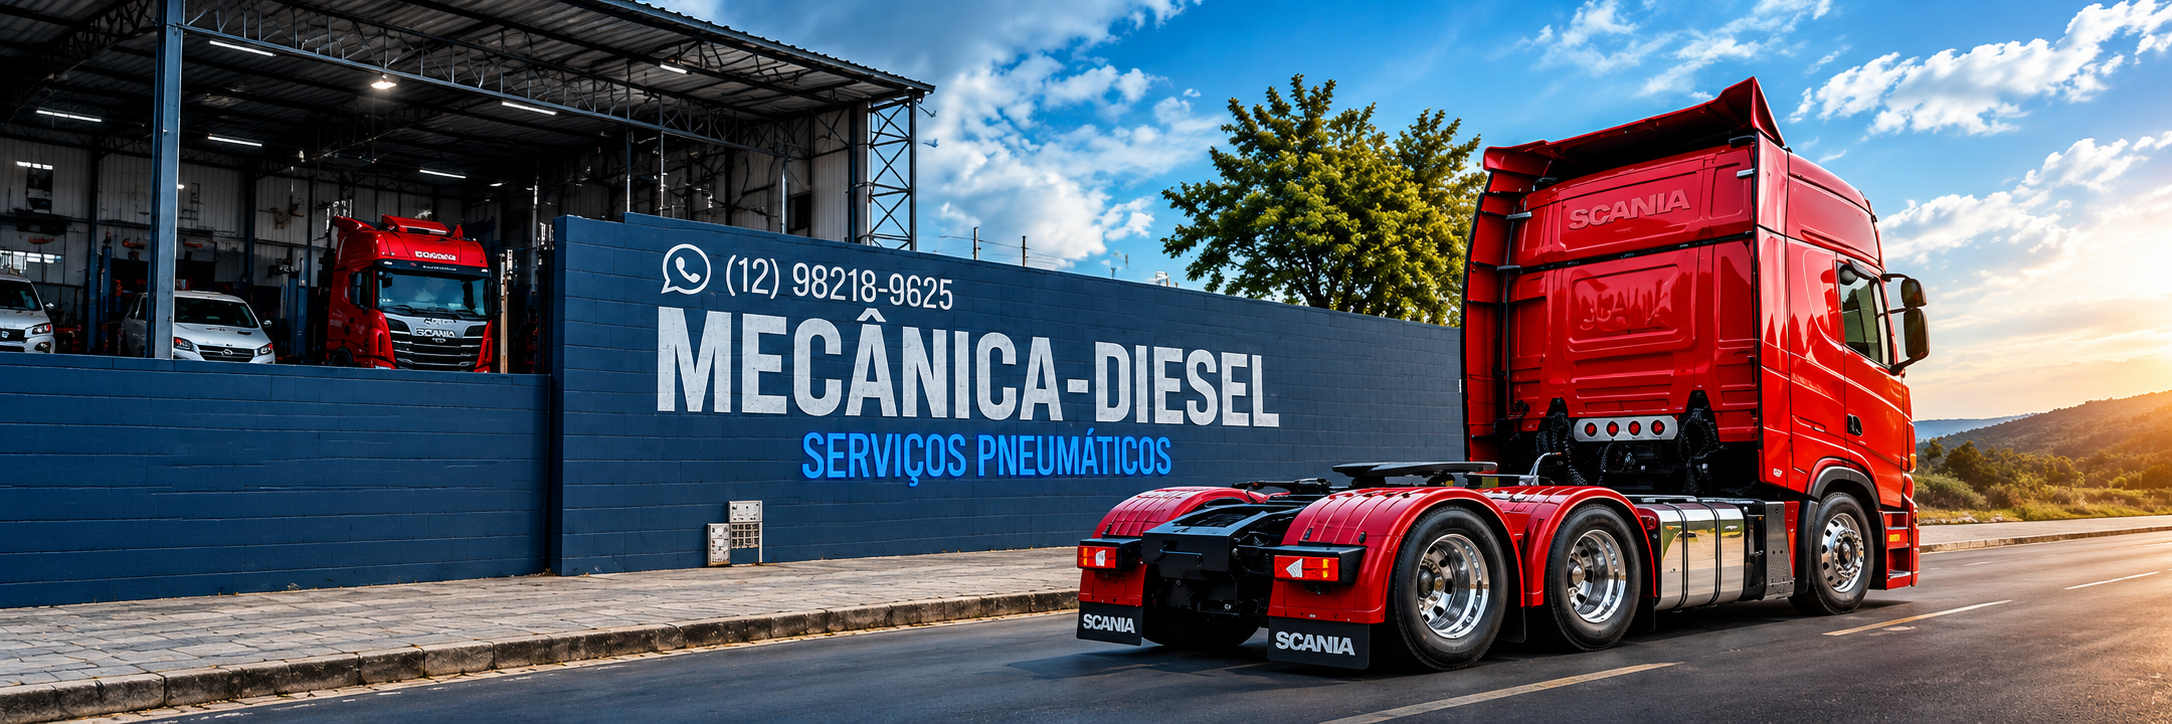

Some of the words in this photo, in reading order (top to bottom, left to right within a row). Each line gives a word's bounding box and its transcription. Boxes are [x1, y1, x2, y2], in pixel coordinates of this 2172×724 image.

[1568, 189, 1691, 230] SCANIA
[726, 254, 780, 300] (12)
[792, 262, 954, 311] 98218-9625
[656, 306, 1281, 428] MECÂNICA-DIESEL
[801, 431, 968, 488] SERVIÇOS
[976, 427, 1173, 477] PNEUMÁTICOS
[1083, 613, 1136, 634] SCANIA
[1275, 631, 1356, 656] SCANIA
